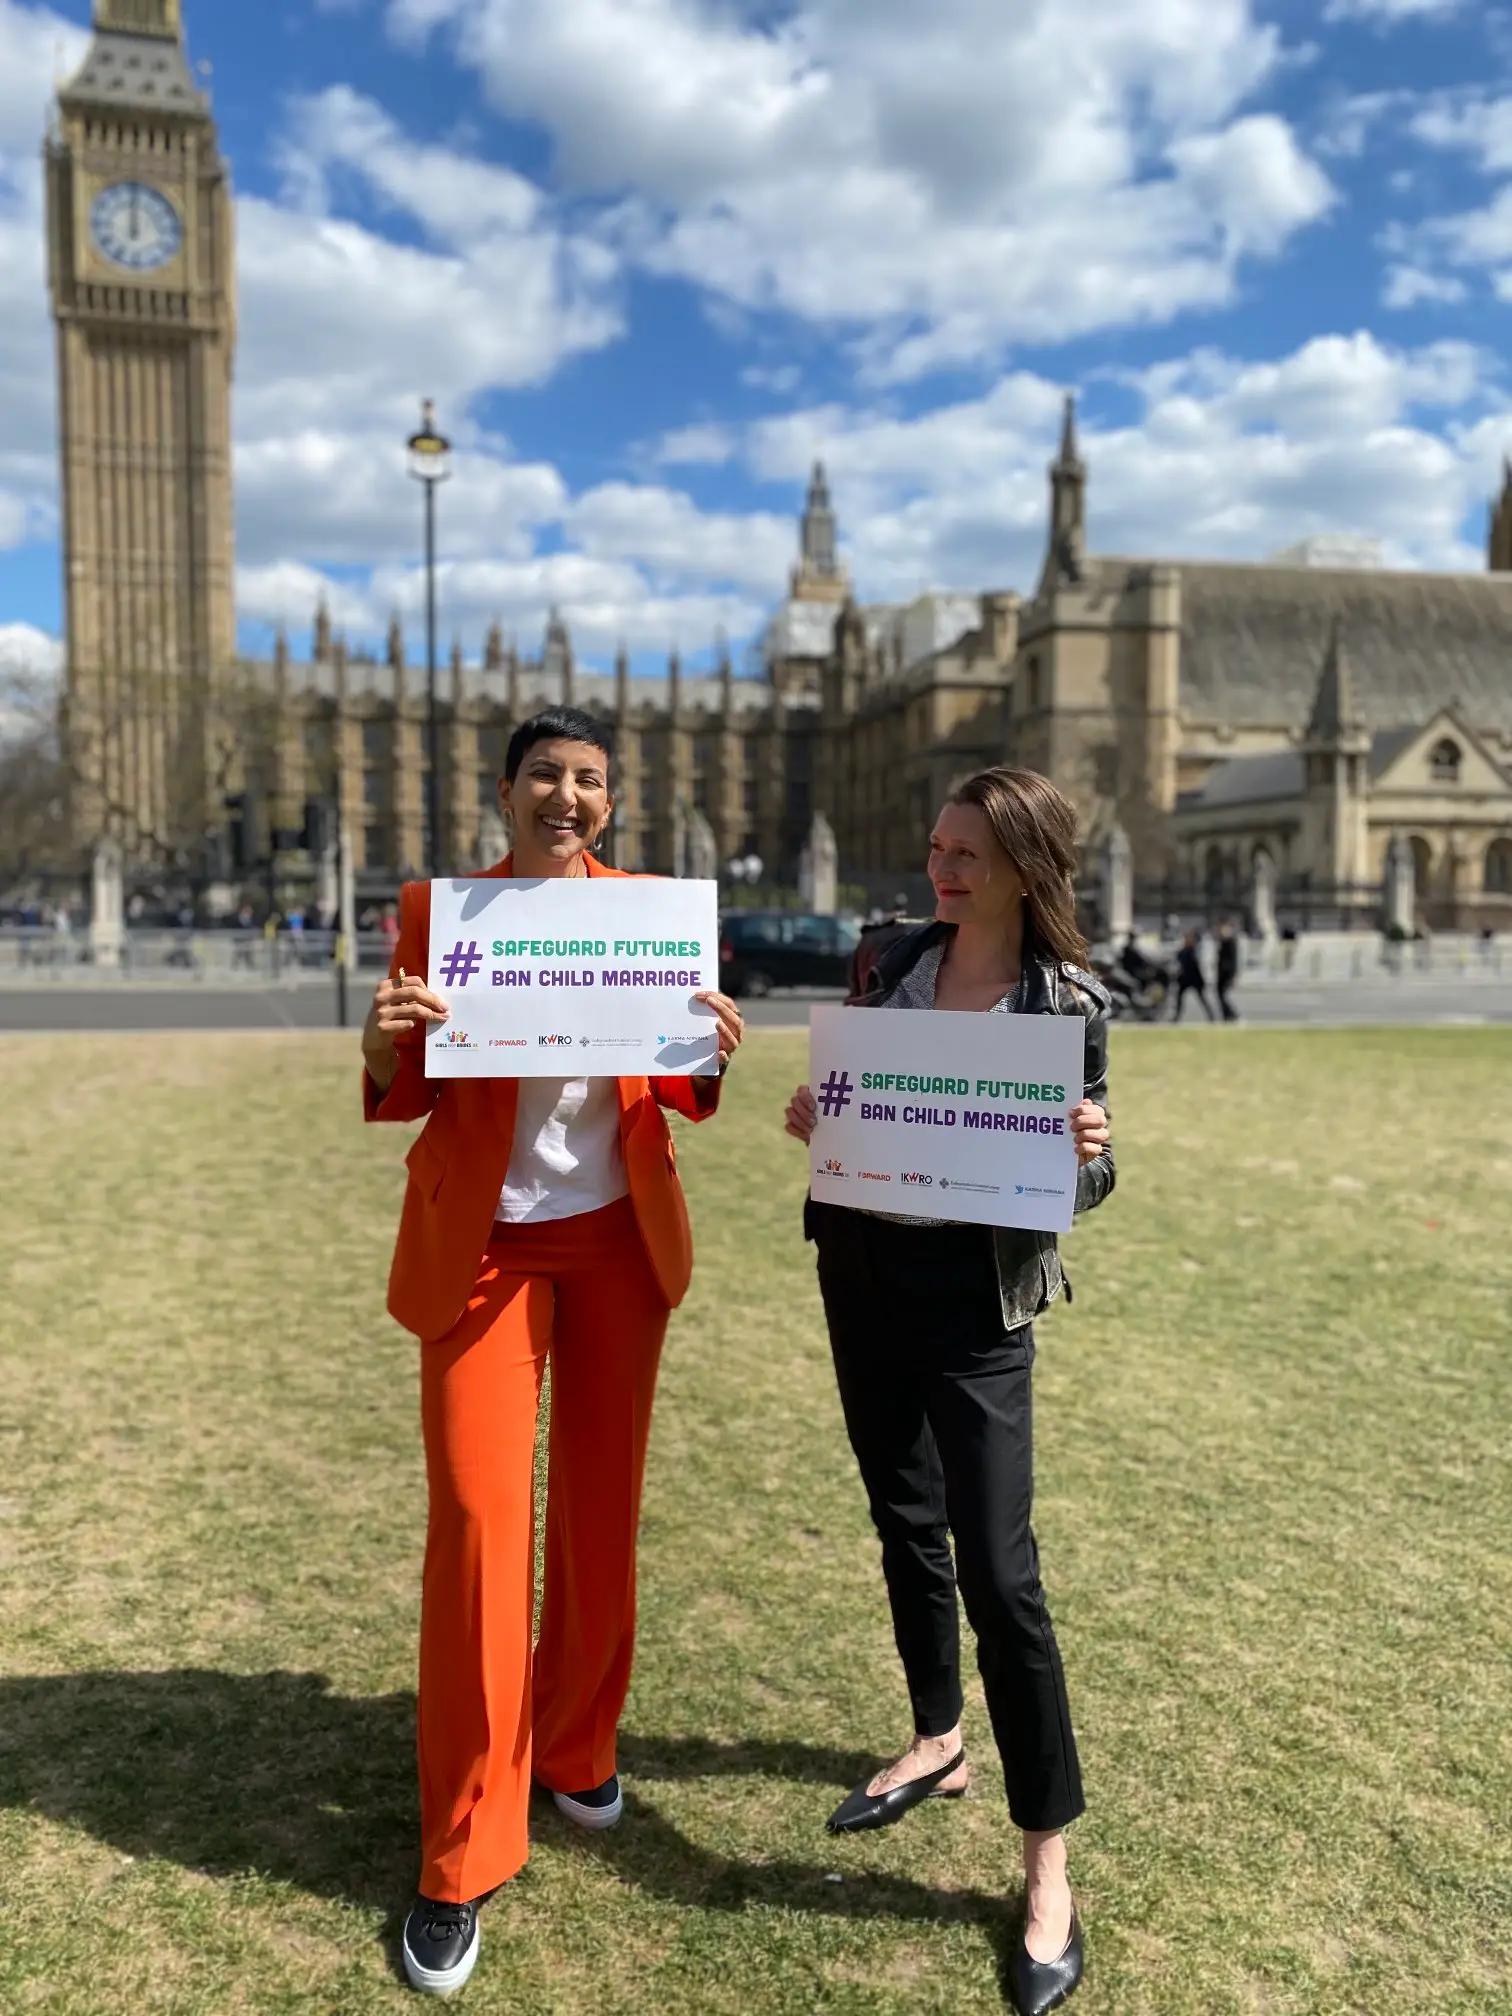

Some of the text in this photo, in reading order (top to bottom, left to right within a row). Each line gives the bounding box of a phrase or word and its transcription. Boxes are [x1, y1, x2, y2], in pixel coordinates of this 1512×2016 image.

[491, 940, 702, 958] SAFEGUARD FUTURES
[439, 940, 483, 987] #
[491, 970, 702, 987] BAN CHILD MARRIAGE
[489, 1039, 527, 1047] FORWARD
[538, 1034, 573, 1045] IKWRO
[817, 1070, 854, 1118] #
[861, 1072, 1066, 1103] SAFEGUARD FUTURES
[860, 1103, 1065, 1136] BAN CHILD MARRIAGE
[857, 1171, 891, 1182] FORWARD
[900, 1171, 933, 1185] IKWRO
